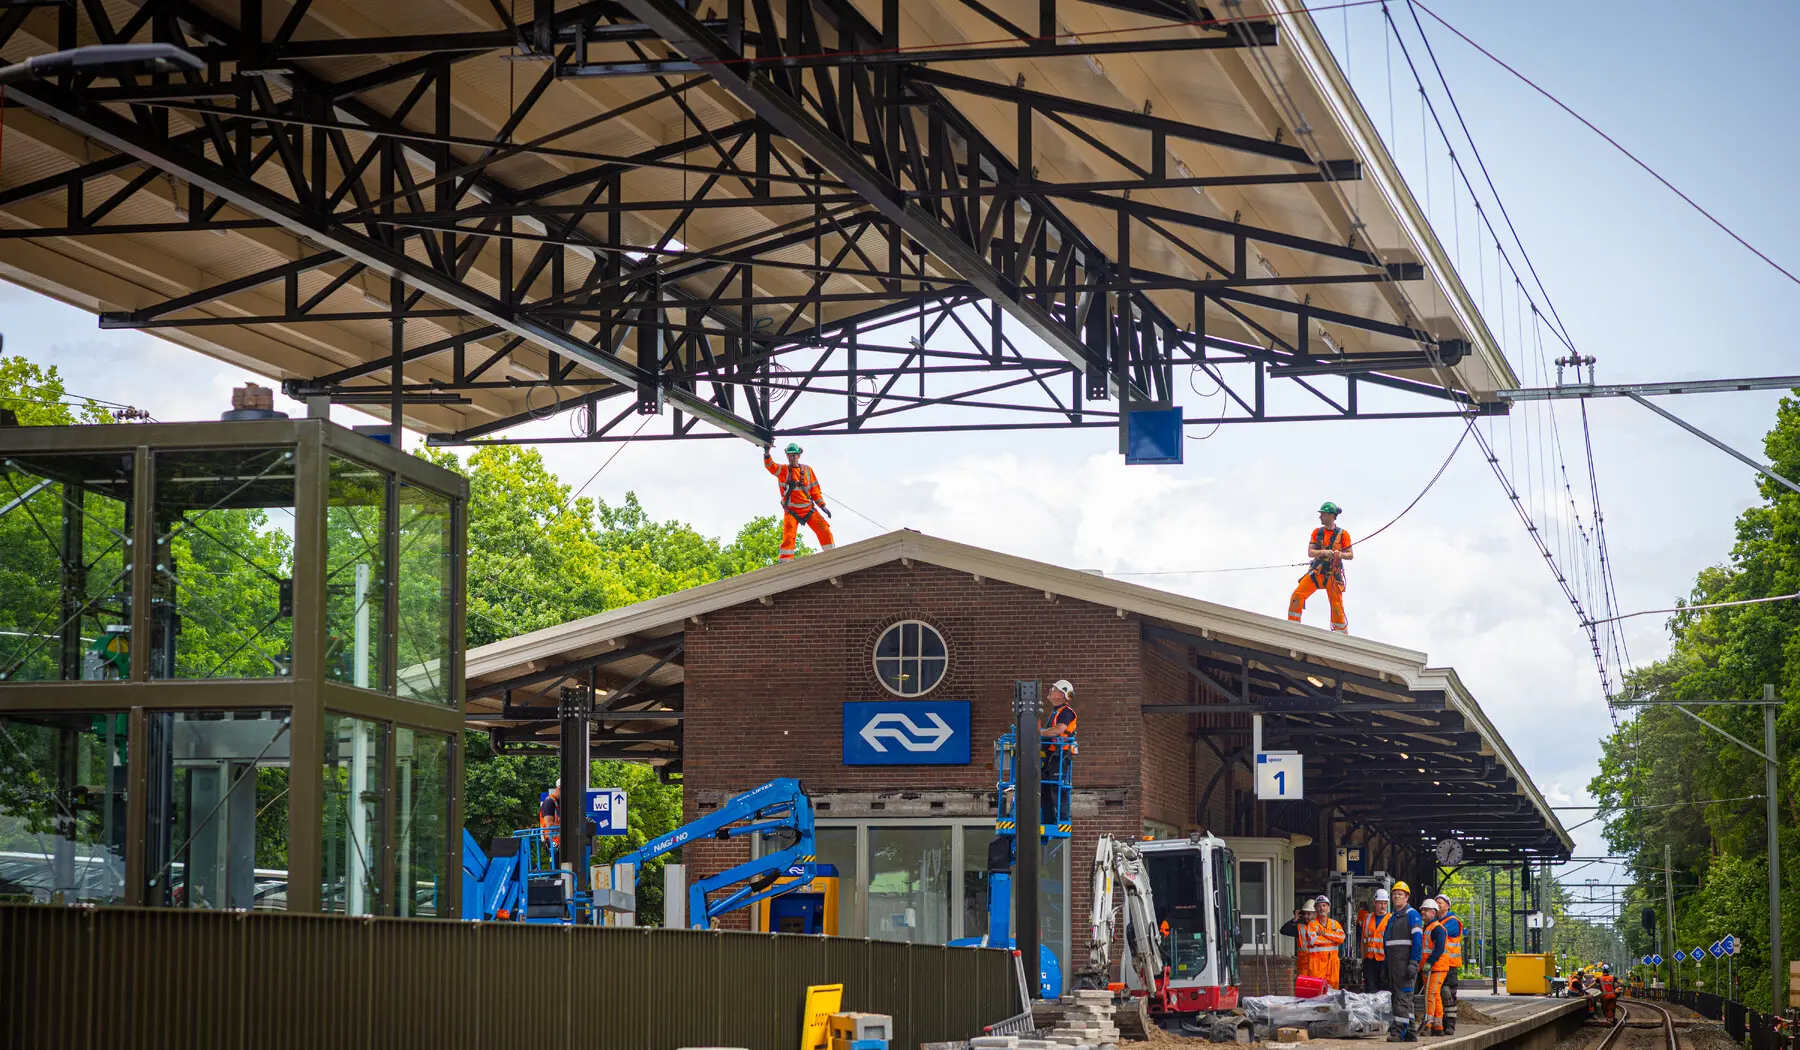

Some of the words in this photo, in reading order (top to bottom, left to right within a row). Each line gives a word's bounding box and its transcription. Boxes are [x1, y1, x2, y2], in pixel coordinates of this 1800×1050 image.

[1273, 771, 1284, 795] 1
[653, 832, 688, 852] NAGANO
[1533, 918, 1537, 926] 1
[1726, 940, 1734, 950] 3
[1695, 950, 1701, 958] 5
